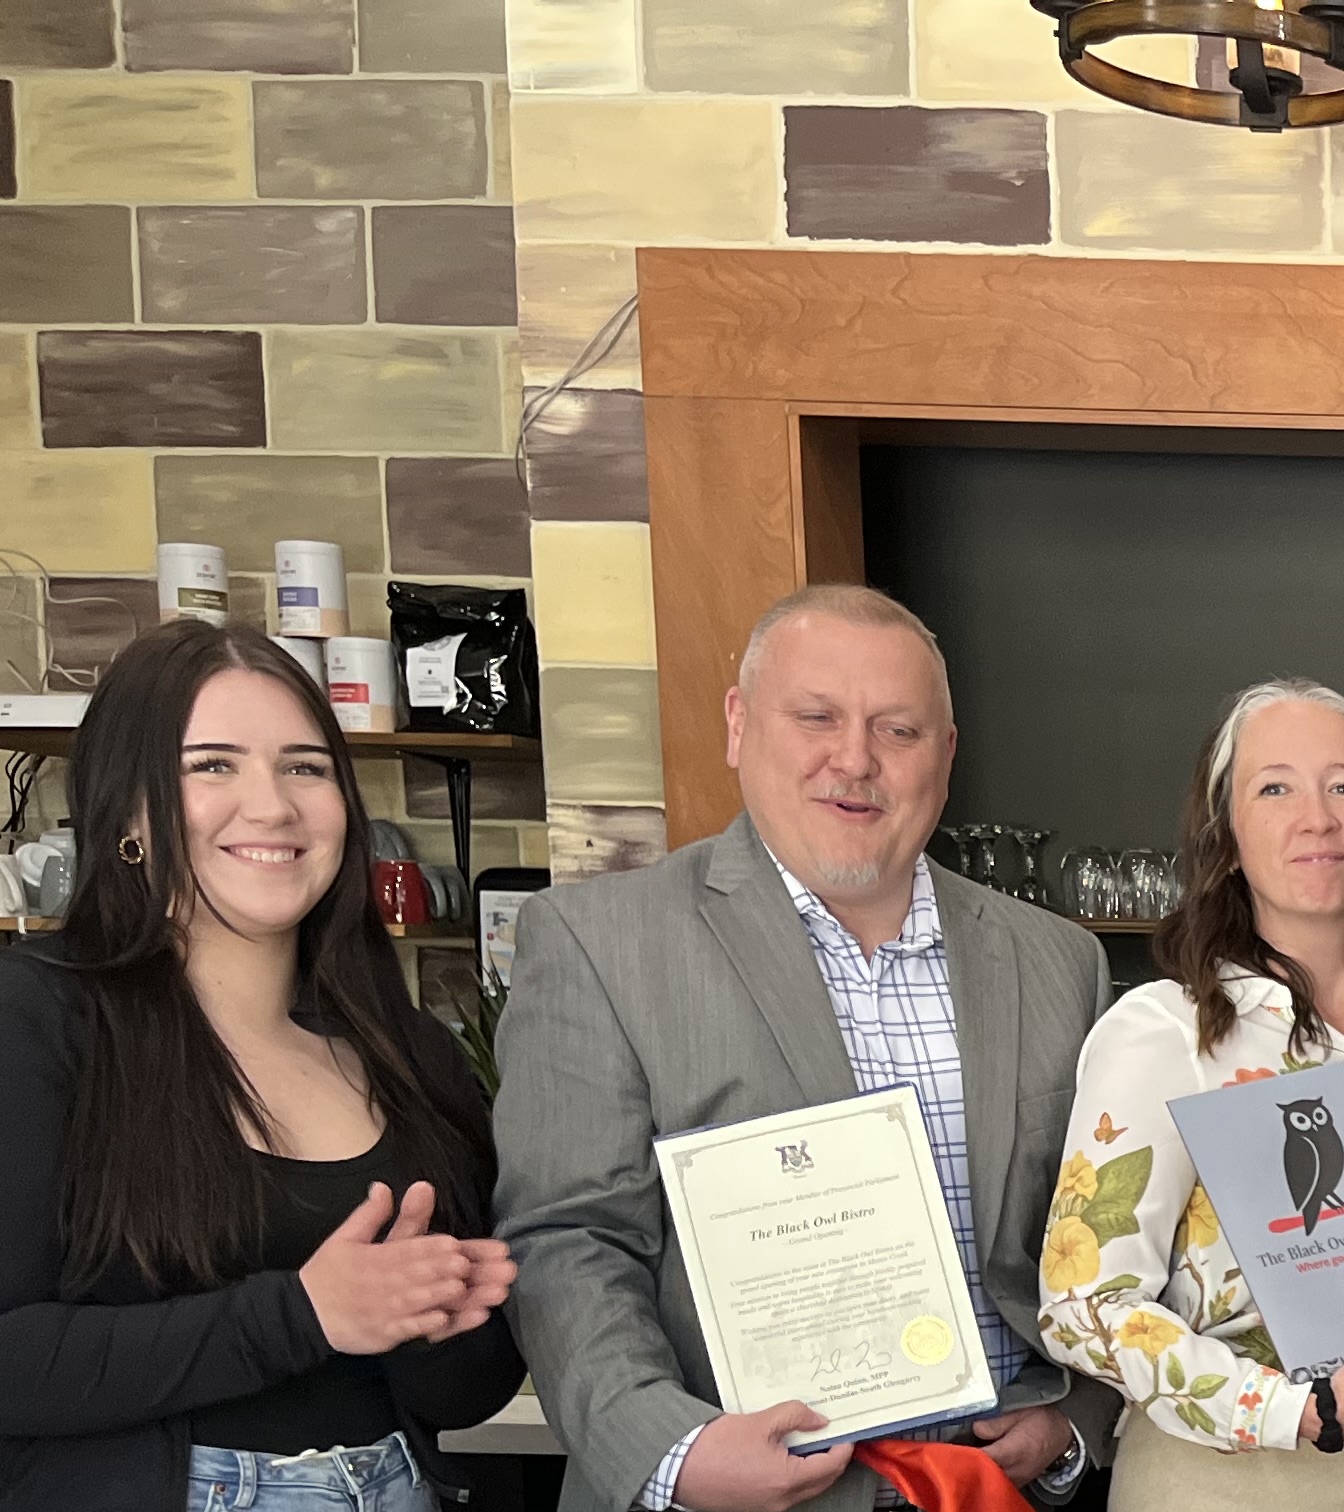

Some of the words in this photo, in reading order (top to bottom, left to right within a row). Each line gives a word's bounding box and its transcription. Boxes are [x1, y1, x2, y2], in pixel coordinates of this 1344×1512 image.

[749, 1228, 772, 1241] The
[776, 1219, 809, 1236] Black
[813, 1212, 836, 1227] Owl
[841, 1207, 874, 1221] Bistro
[1255, 1251, 1285, 1267] The
[1286, 1239, 1326, 1260] Black
[1295, 1259, 1330, 1272] Where
